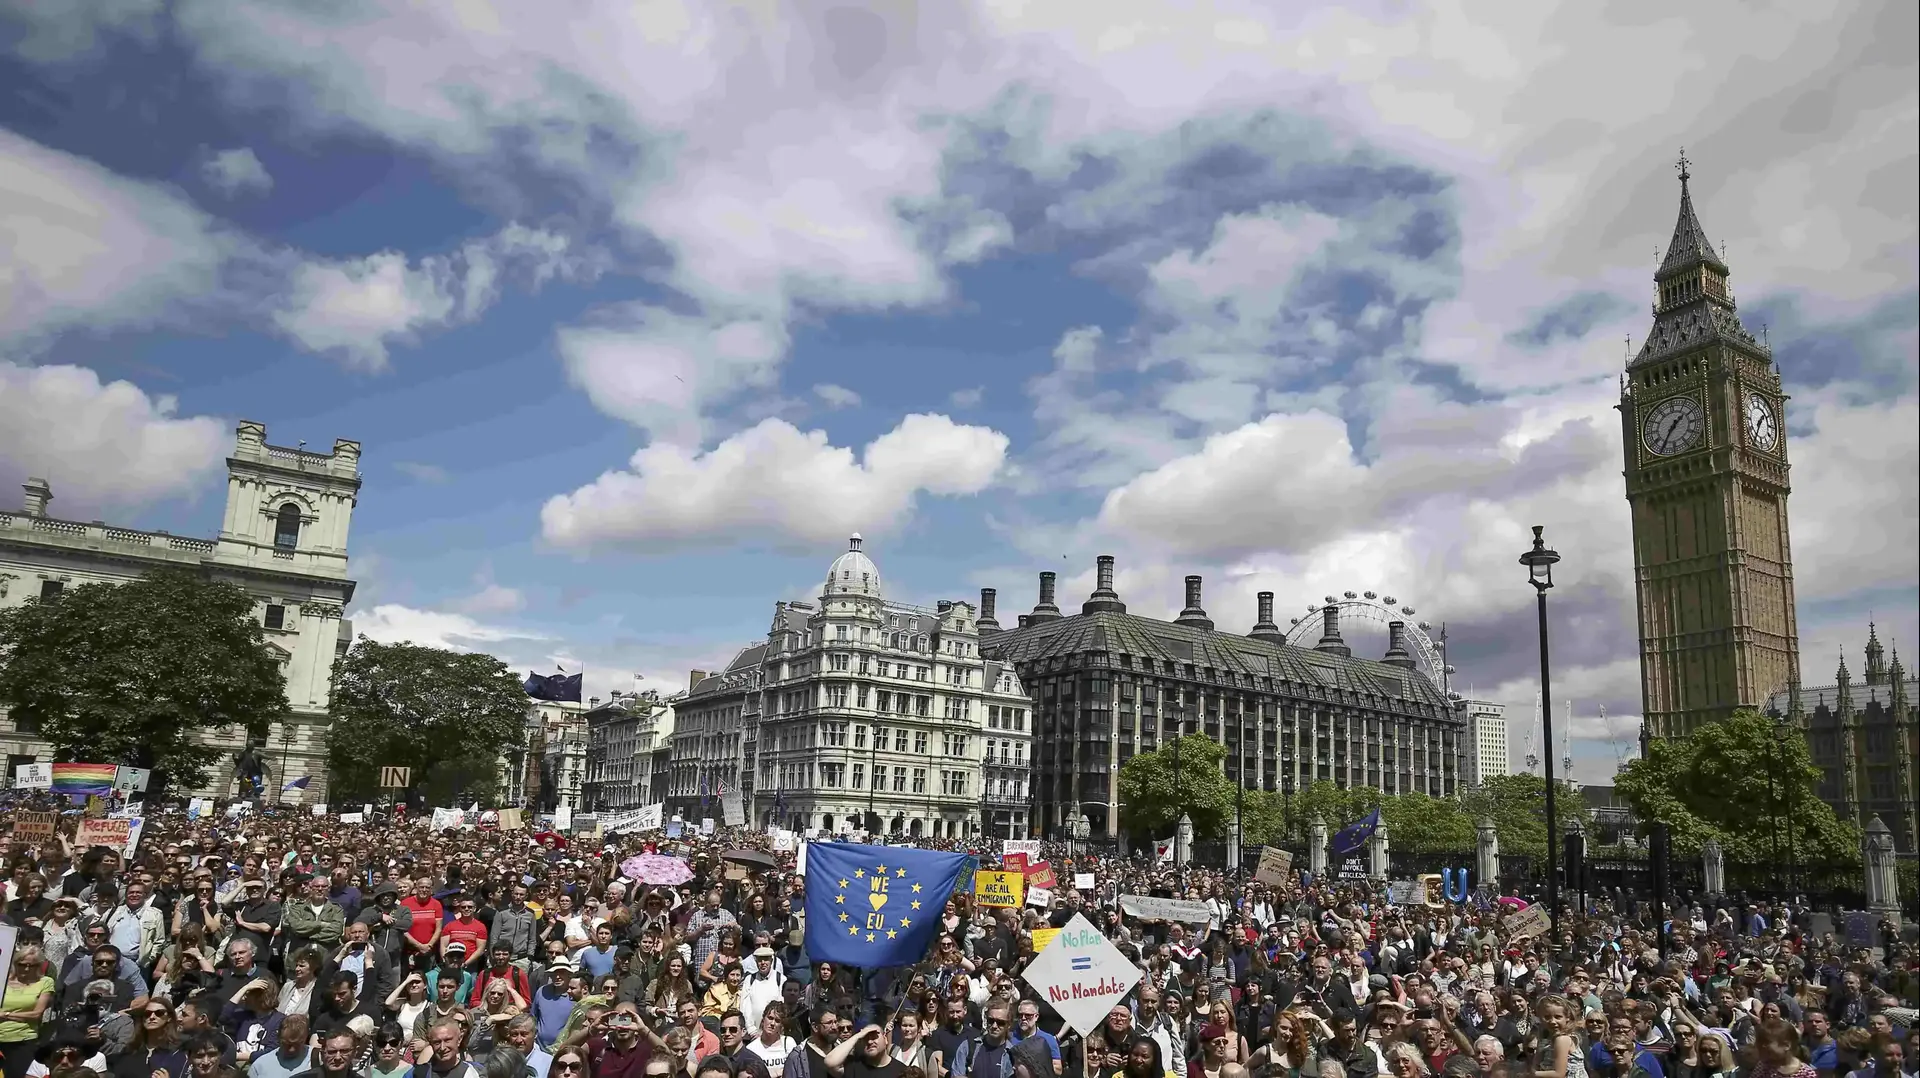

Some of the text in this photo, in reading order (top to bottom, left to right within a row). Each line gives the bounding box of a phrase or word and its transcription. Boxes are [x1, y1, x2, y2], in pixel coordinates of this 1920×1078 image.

[20, 775, 47, 784] FUTURE
[384, 767, 407, 786] IN
[17, 812, 57, 824] BRITAIN
[613, 818, 655, 830] MANDATE
[13, 831, 51, 842] EUROPE
[1341, 864, 1364, 872] INVOKE
[871, 876, 890, 893] WE
[994, 874, 1006, 883] WE
[984, 884, 1010, 893] ARE ALL
[976, 893, 1016, 905] IMMIGRANTS
[866, 912, 884, 930] EU
[1062, 932, 1079, 948] No
[1079, 930, 1101, 947] Plan
[1048, 976, 1125, 1003] No Mandate
